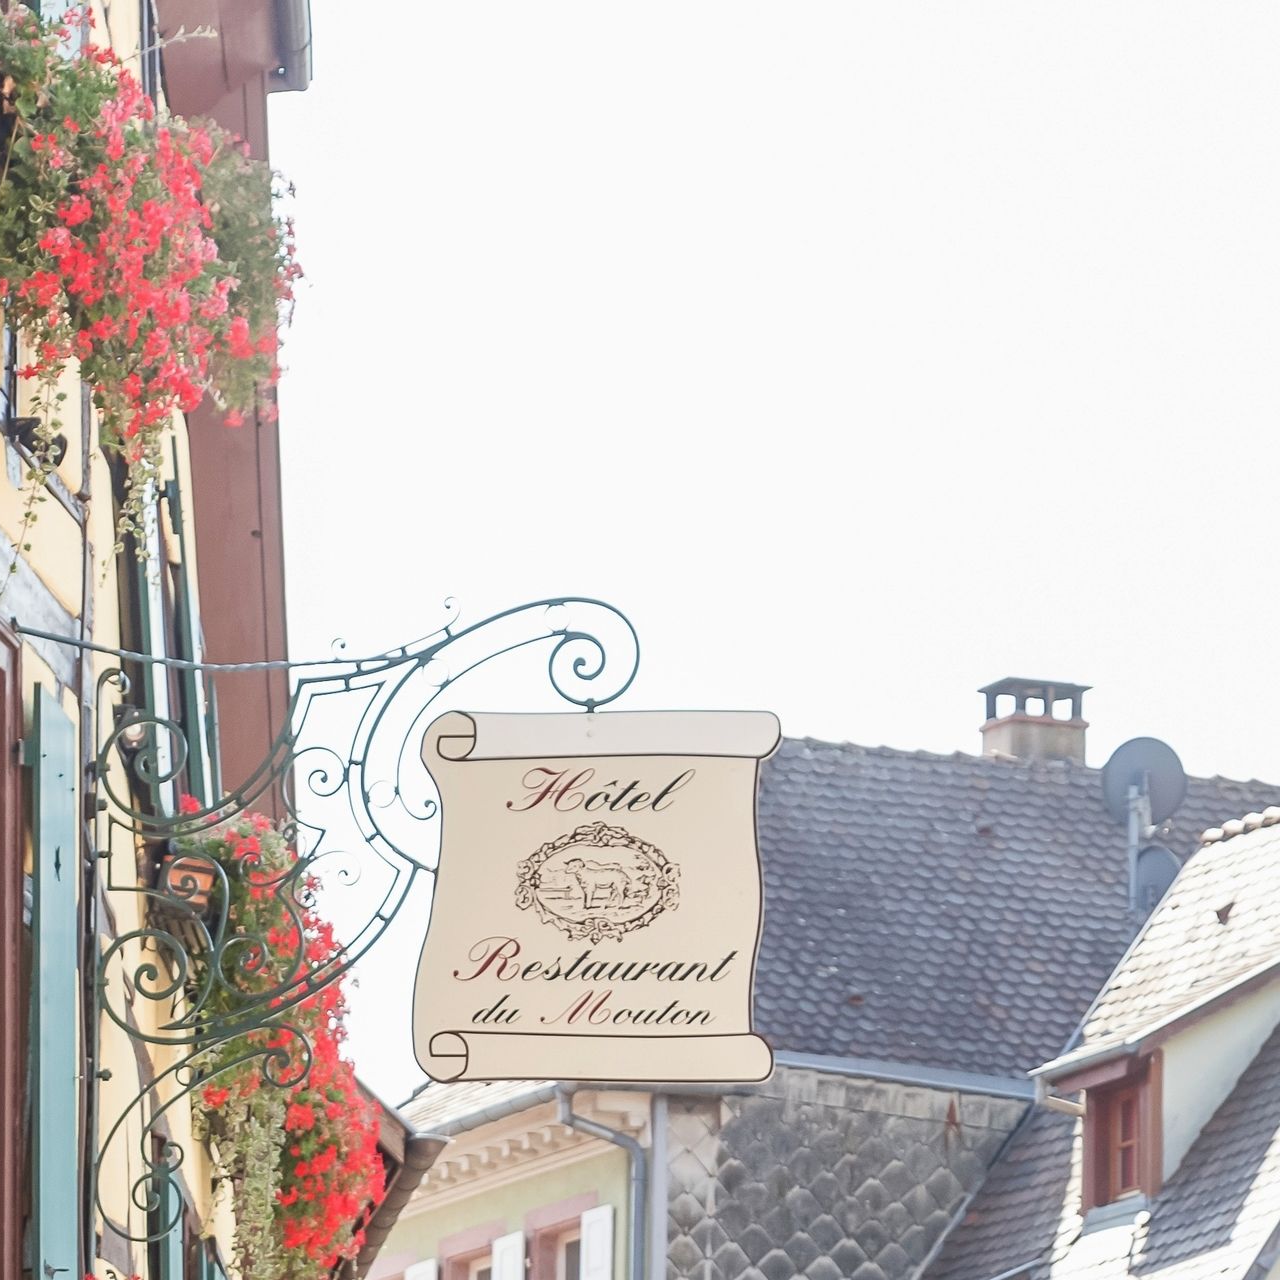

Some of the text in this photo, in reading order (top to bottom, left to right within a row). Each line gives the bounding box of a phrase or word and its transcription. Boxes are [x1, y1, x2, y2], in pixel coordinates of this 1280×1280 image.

[506, 767, 696, 812] Hôtel
[452, 936, 738, 983] Restaurant
[471, 989, 717, 1026] du Mouton
